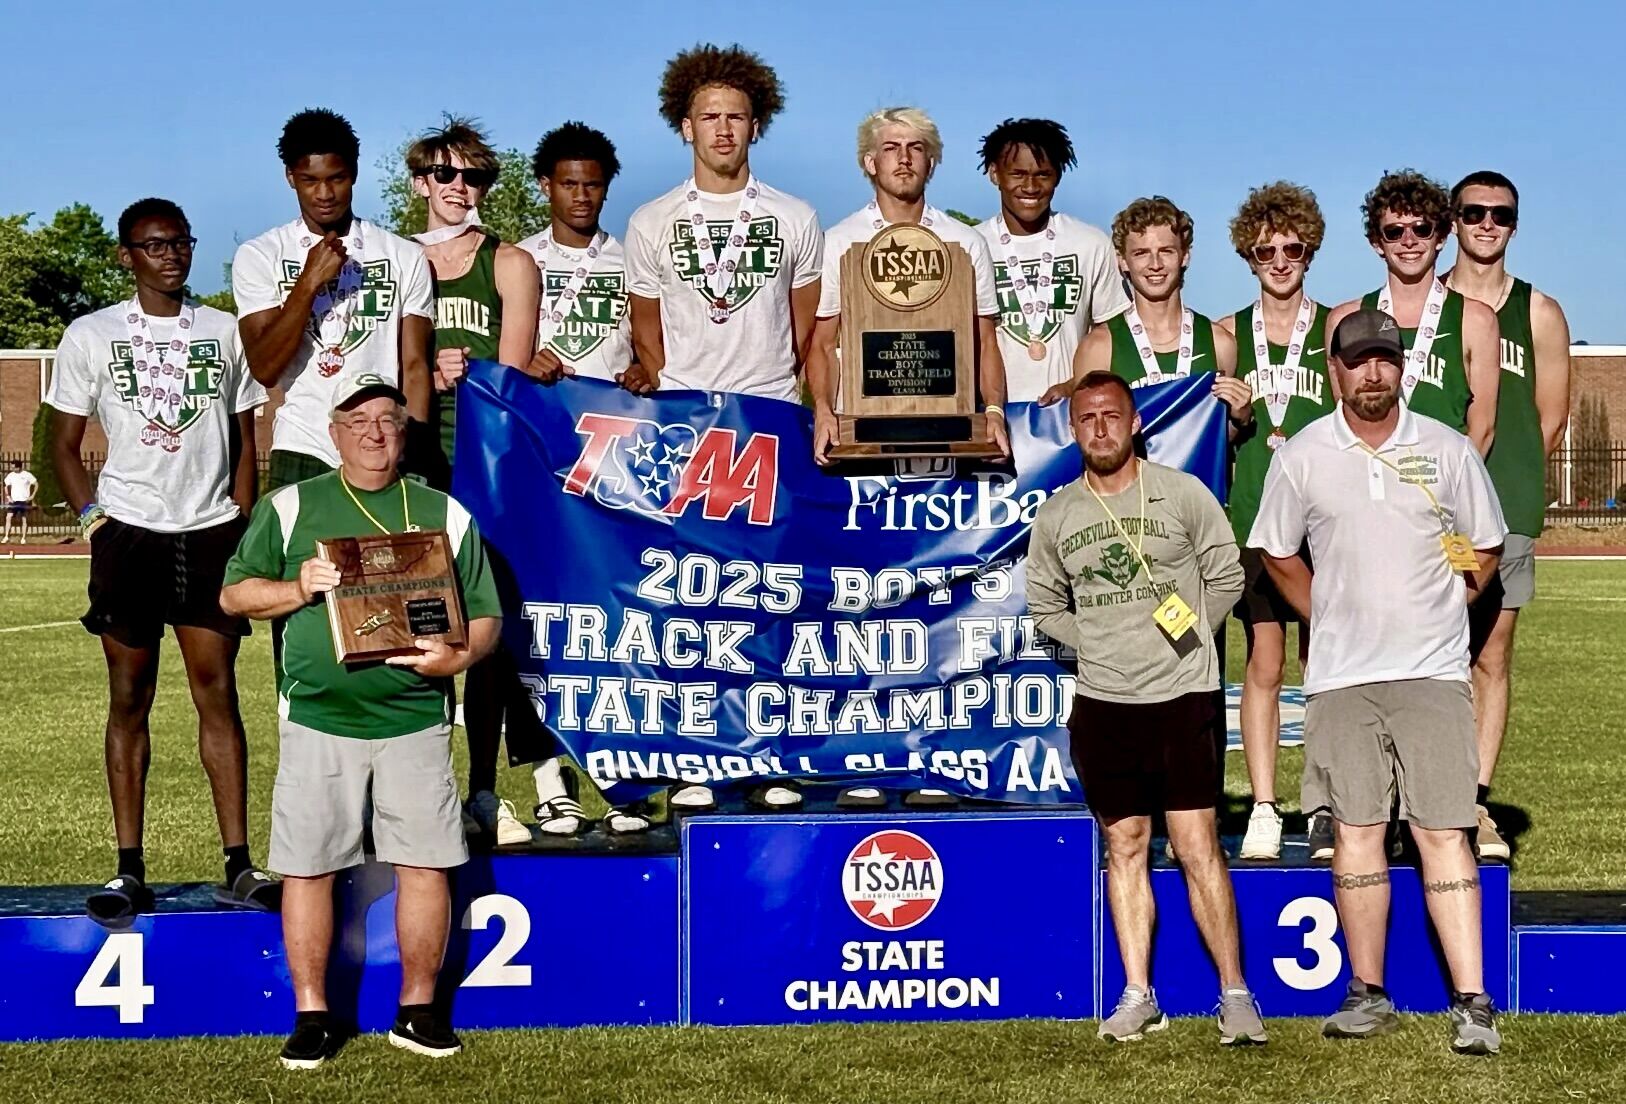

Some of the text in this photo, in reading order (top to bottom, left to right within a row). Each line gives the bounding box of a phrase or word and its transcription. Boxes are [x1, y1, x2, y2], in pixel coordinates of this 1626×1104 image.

[755, 225, 770, 235] 25
[367, 267, 382, 278] 25
[873, 251, 941, 277] TSSAA
[553, 320, 613, 337] OUND
[198, 346, 213, 356] 25
[878, 350, 940, 360] CHAMPIONS
[892, 340, 926, 350] STATE
[867, 368, 952, 379] TRACK & FIELD
[895, 360, 924, 369] BOYS
[888, 379, 925, 387] DIVISION
[842, 472, 1076, 532] FirstBa
[1061, 517, 1170, 560] GREENEVILLE FOOTBALL
[341, 584, 378, 597] STATE
[636, 547, 803, 614] 2025
[1095, 590, 1134, 606] WINTER
[521, 602, 755, 674] TRACK
[783, 619, 929, 676] AND
[587, 749, 788, 790] DIVISION
[1006, 747, 1072, 793] AA
[850, 861, 936, 892] TSSAA
[459, 893, 532, 987] 2
[1272, 896, 1343, 990] 3
[841, 940, 945, 972] STATE
[74, 932, 155, 1025] 4
[784, 977, 1000, 1011] CHAMPION
